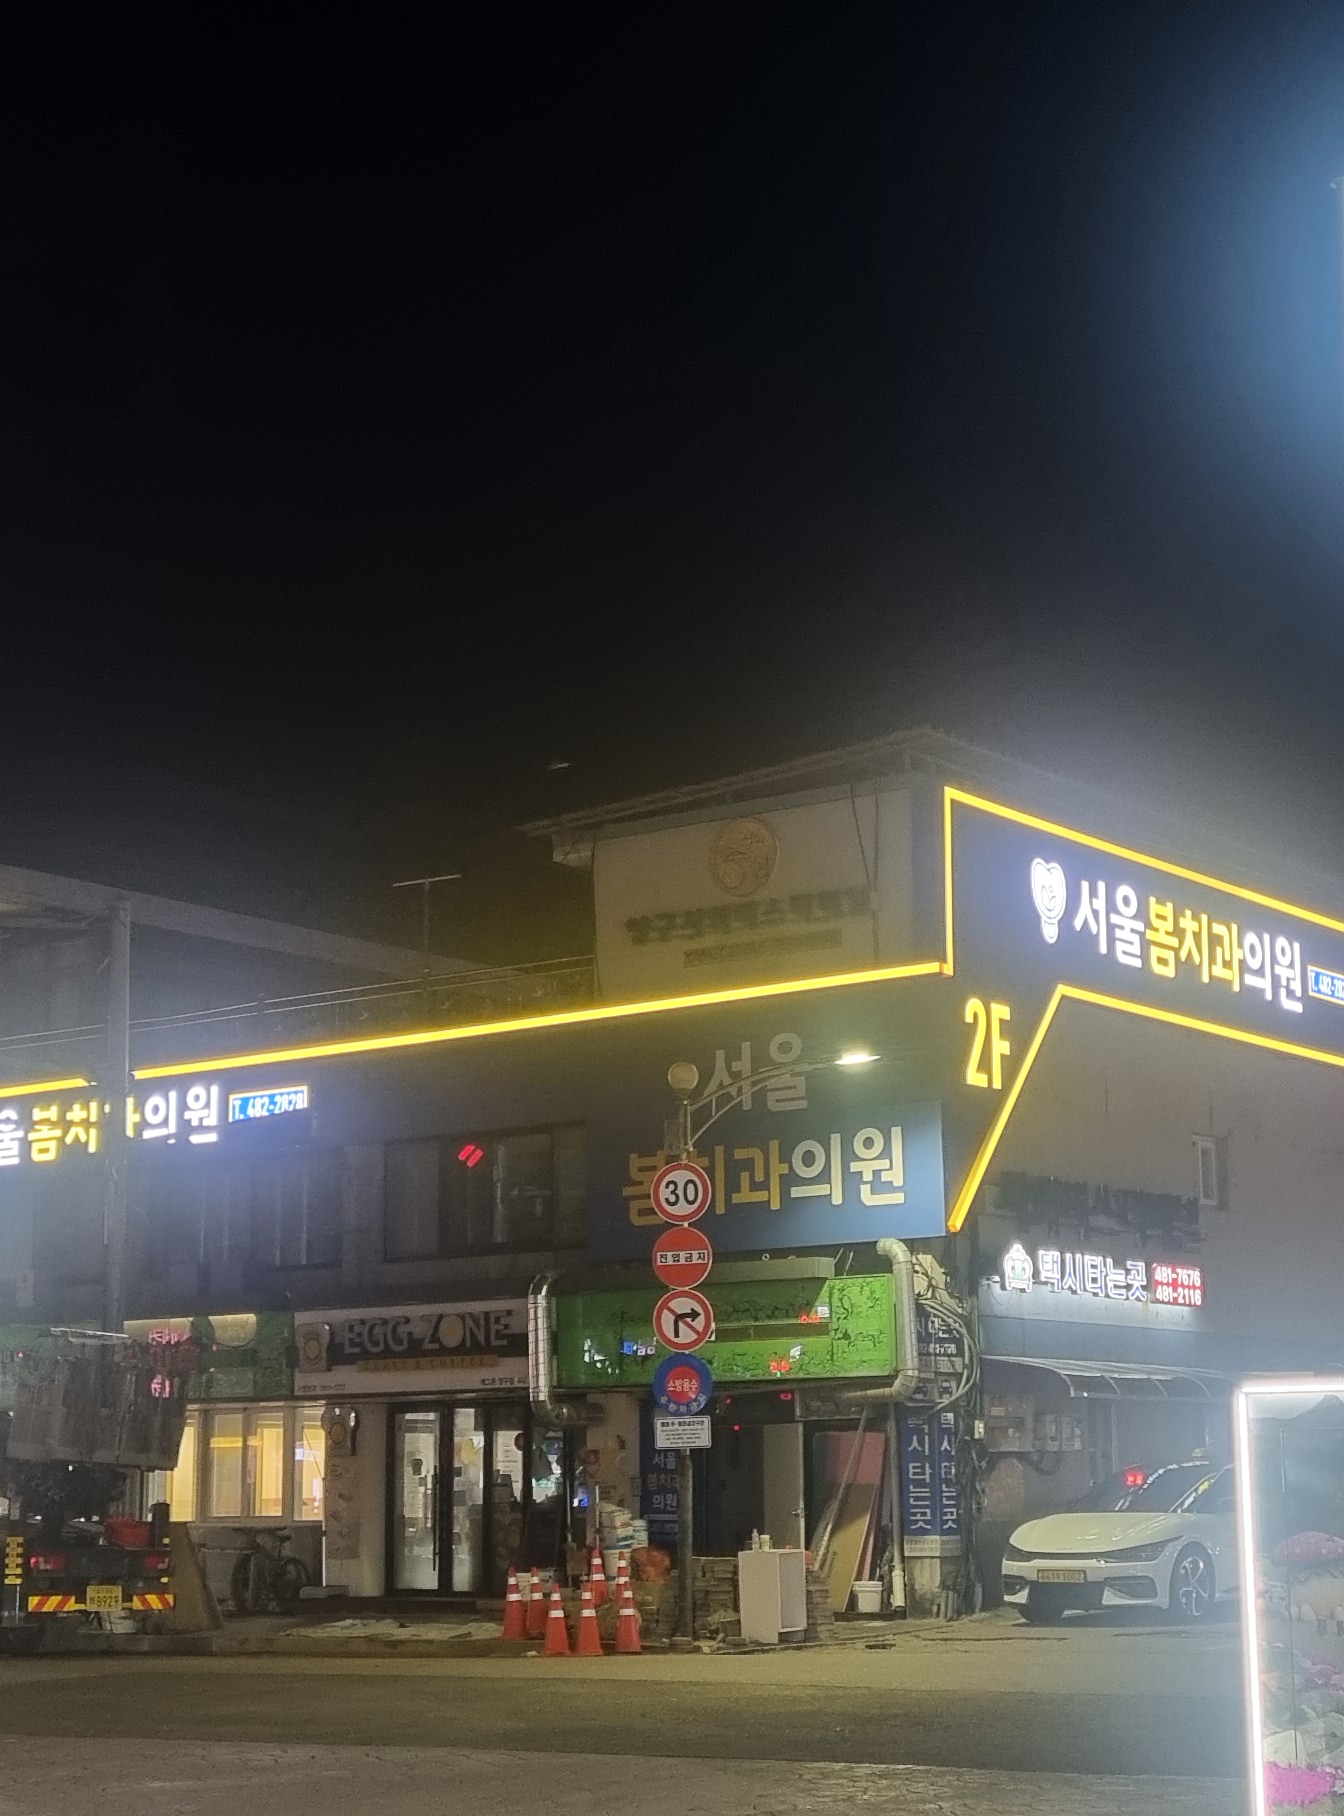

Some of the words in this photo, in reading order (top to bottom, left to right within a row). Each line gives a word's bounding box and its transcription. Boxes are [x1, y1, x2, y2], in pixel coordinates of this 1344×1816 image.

[1074, 880, 1303, 1013] 서울봄치과의원
[964, 998, 1010, 1090] 2F
[703, 1033, 807, 1112] 서울
[665, 1179, 699, 1207] 30
[659, 1252, 706, 1264] 진입금지
[1038, 1249, 1148, 1302] 택시타는곳
[1154, 1265, 1202, 1287] 481-7676
[1154, 1285, 1202, 1306] 481-2116
[667, 1379, 698, 1392] 소방용수
